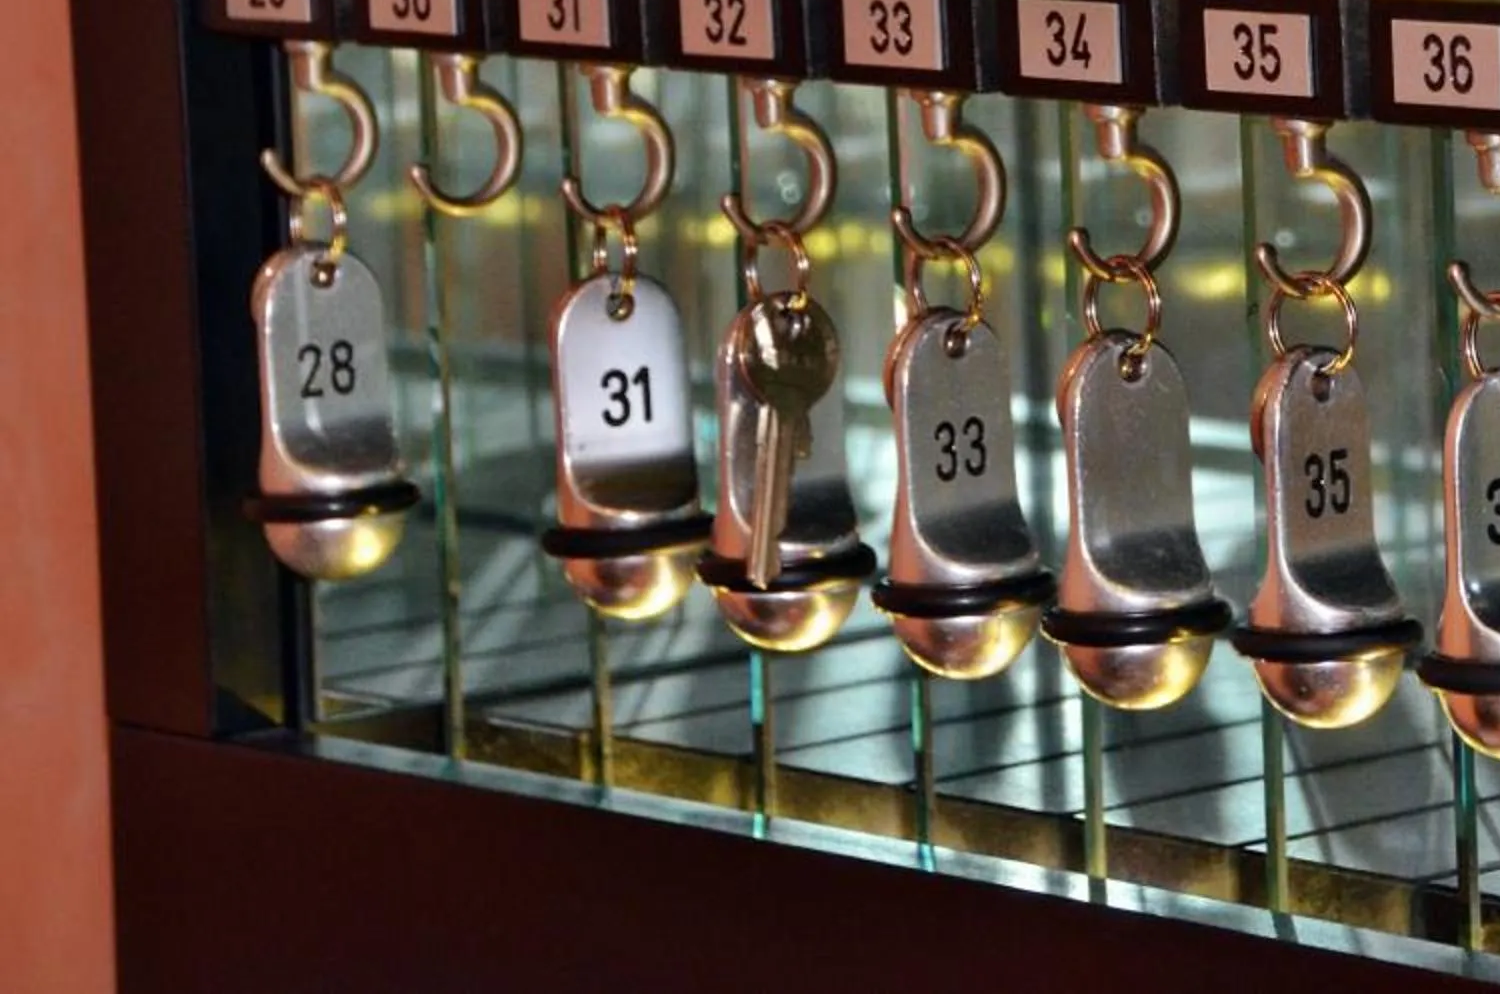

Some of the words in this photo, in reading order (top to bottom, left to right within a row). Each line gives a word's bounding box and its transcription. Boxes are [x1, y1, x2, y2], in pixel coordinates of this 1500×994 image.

[869, 0, 913, 56] 33
[1045, 10, 1092, 69] 34
[1233, 22, 1282, 83] 35
[1422, 33, 1474, 95] 36
[297, 339, 356, 399] 28
[600, 366, 653, 427] 31
[934, 416, 987, 482] 33
[1303, 448, 1351, 519] 35
